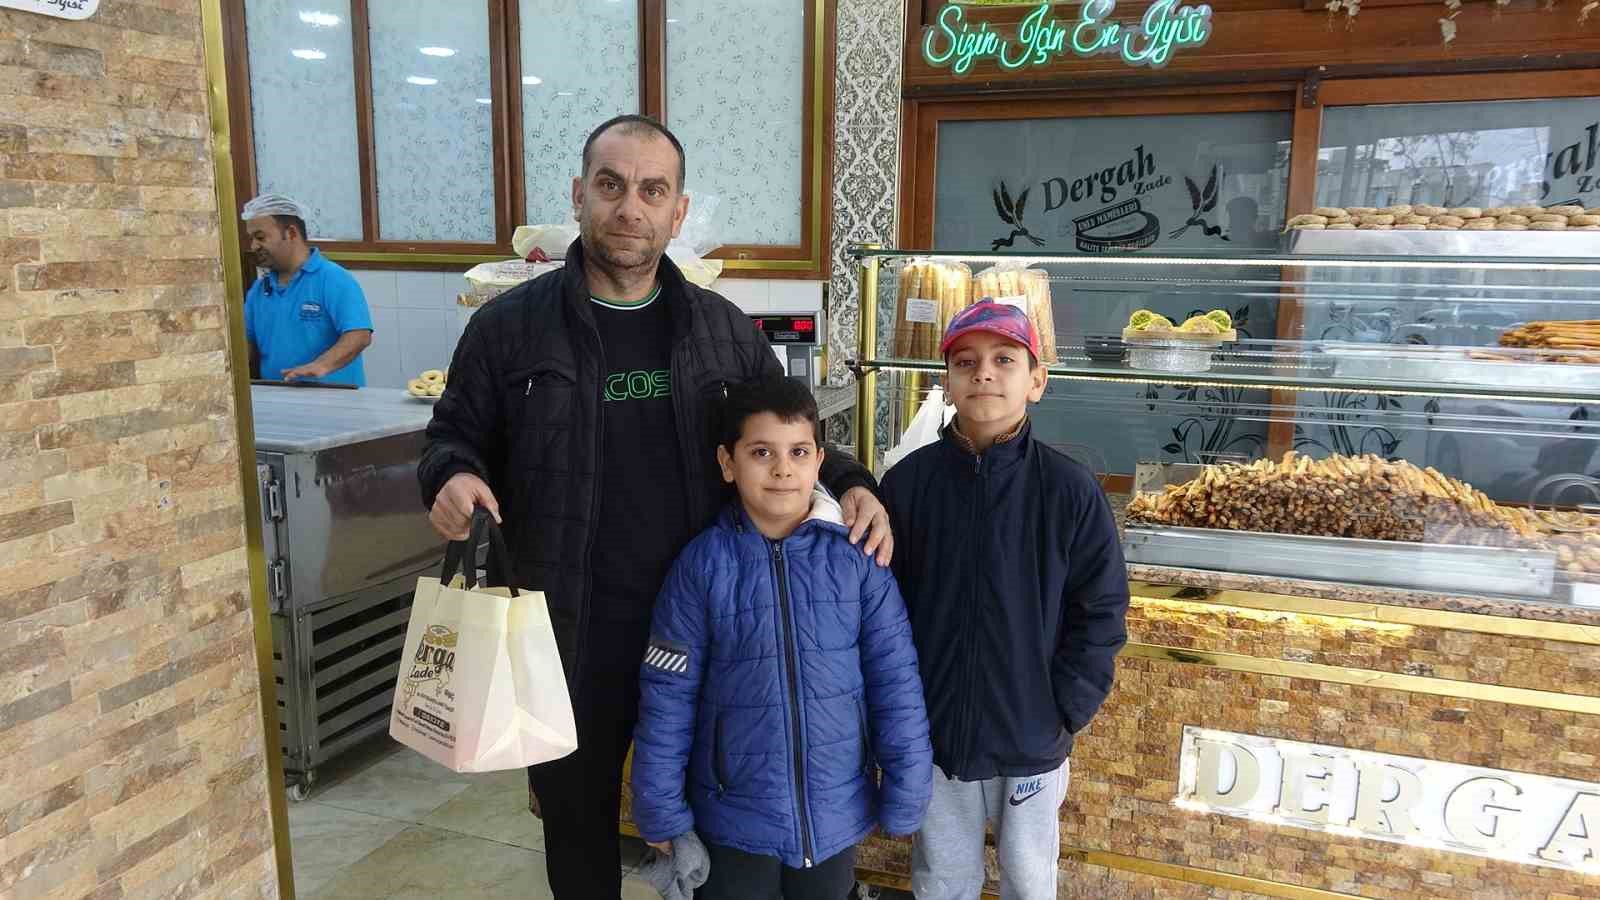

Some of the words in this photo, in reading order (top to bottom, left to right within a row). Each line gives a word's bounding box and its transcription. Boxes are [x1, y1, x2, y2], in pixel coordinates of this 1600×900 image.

[926, 6, 999, 73] Sizin
[1073, 0, 1119, 52] En
[1041, 144, 1155, 214] Dergah
[1133, 175, 1172, 195] Zade
[1016, 777, 1042, 795] NIKE
